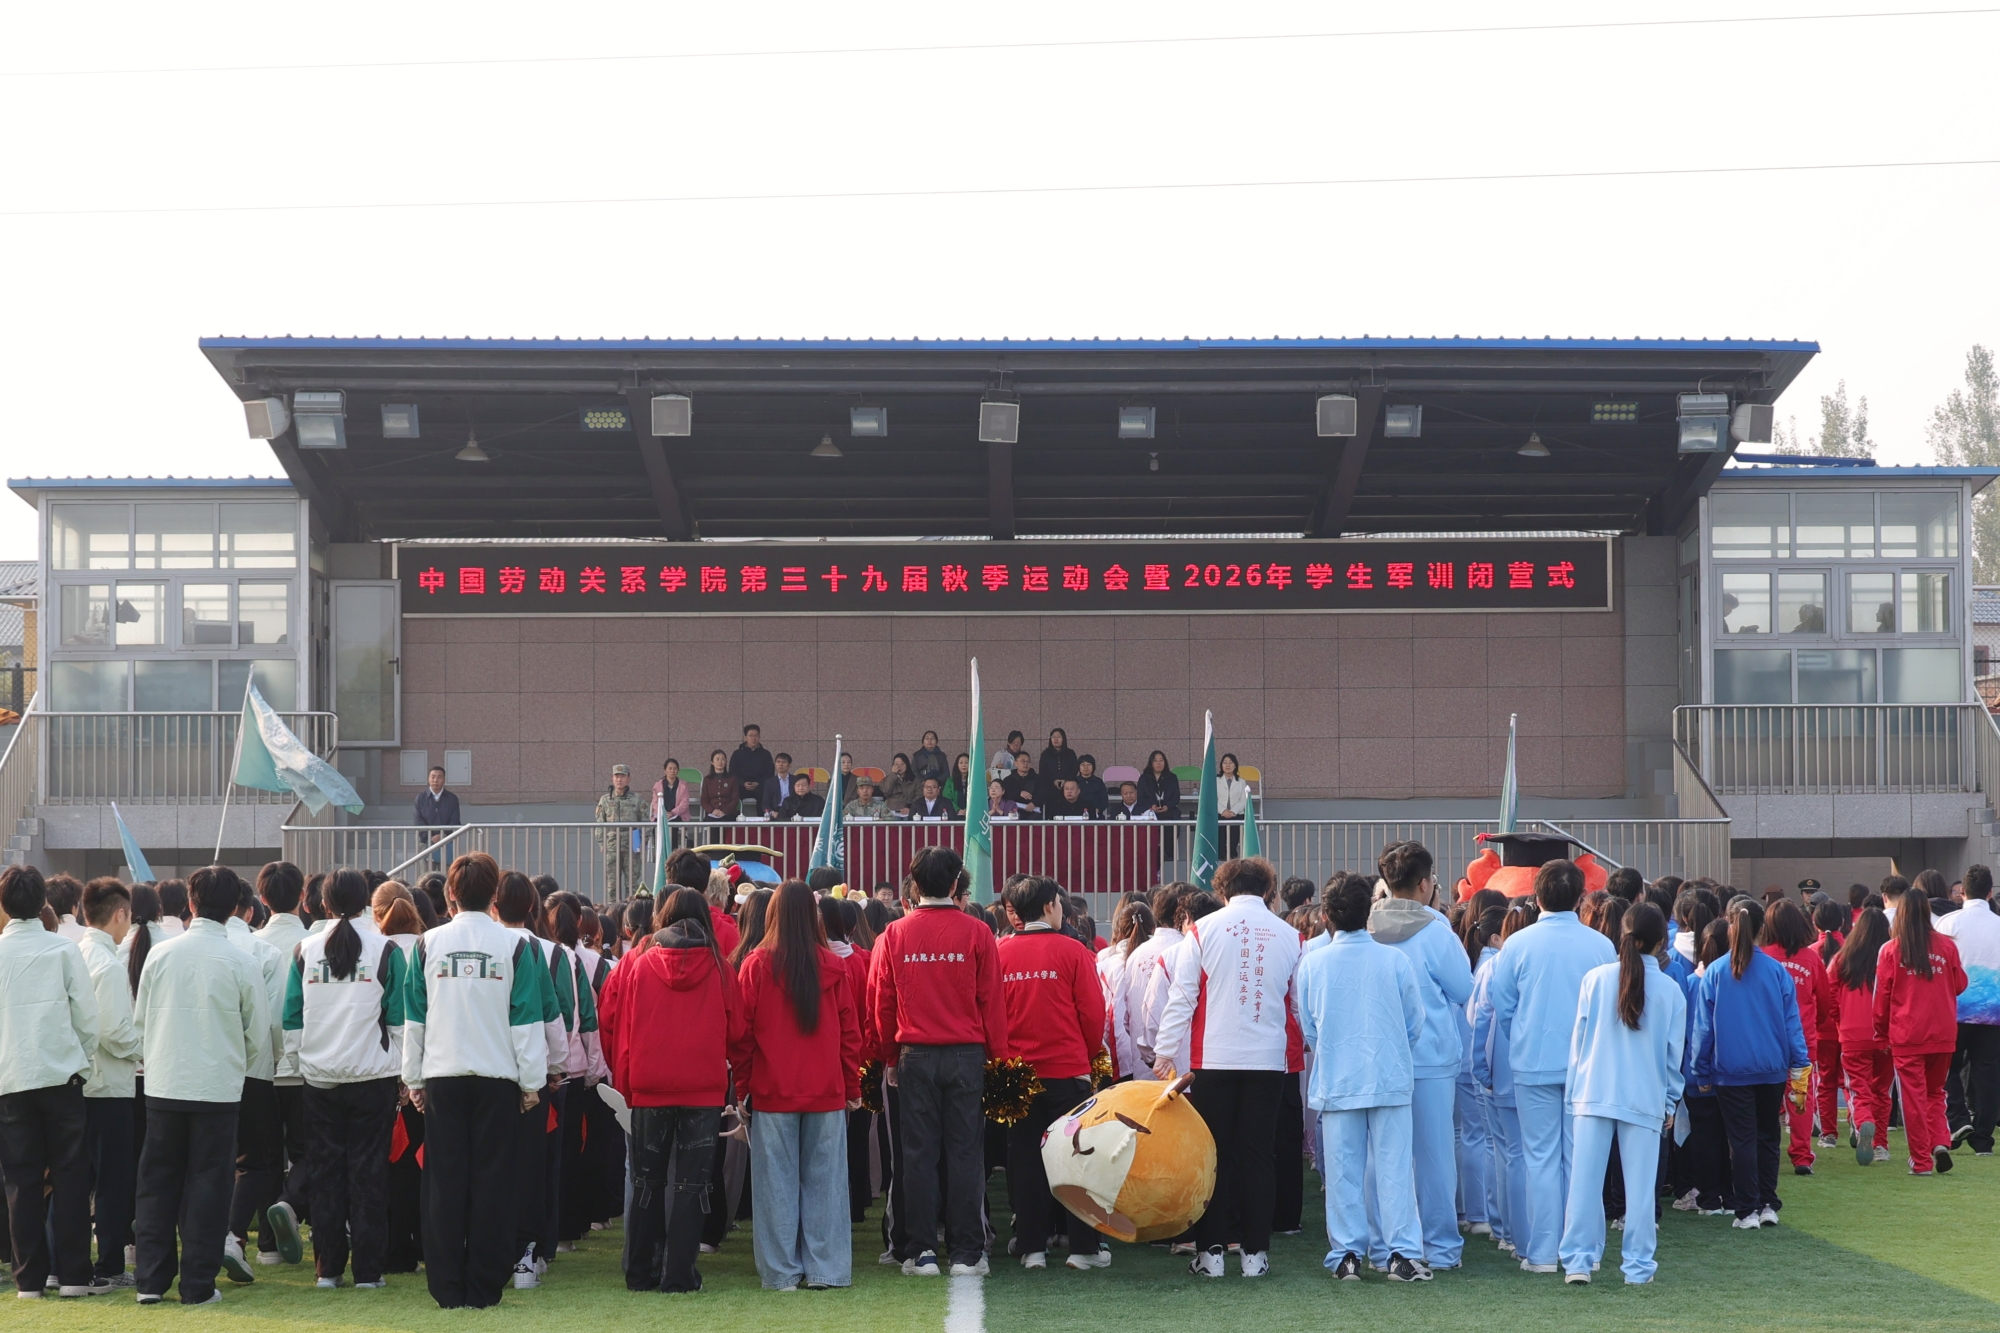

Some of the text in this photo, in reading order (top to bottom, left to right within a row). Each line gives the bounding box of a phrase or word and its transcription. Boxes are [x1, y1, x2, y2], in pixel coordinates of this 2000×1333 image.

[1253, 943, 1264, 1023] 为中国工会育才
